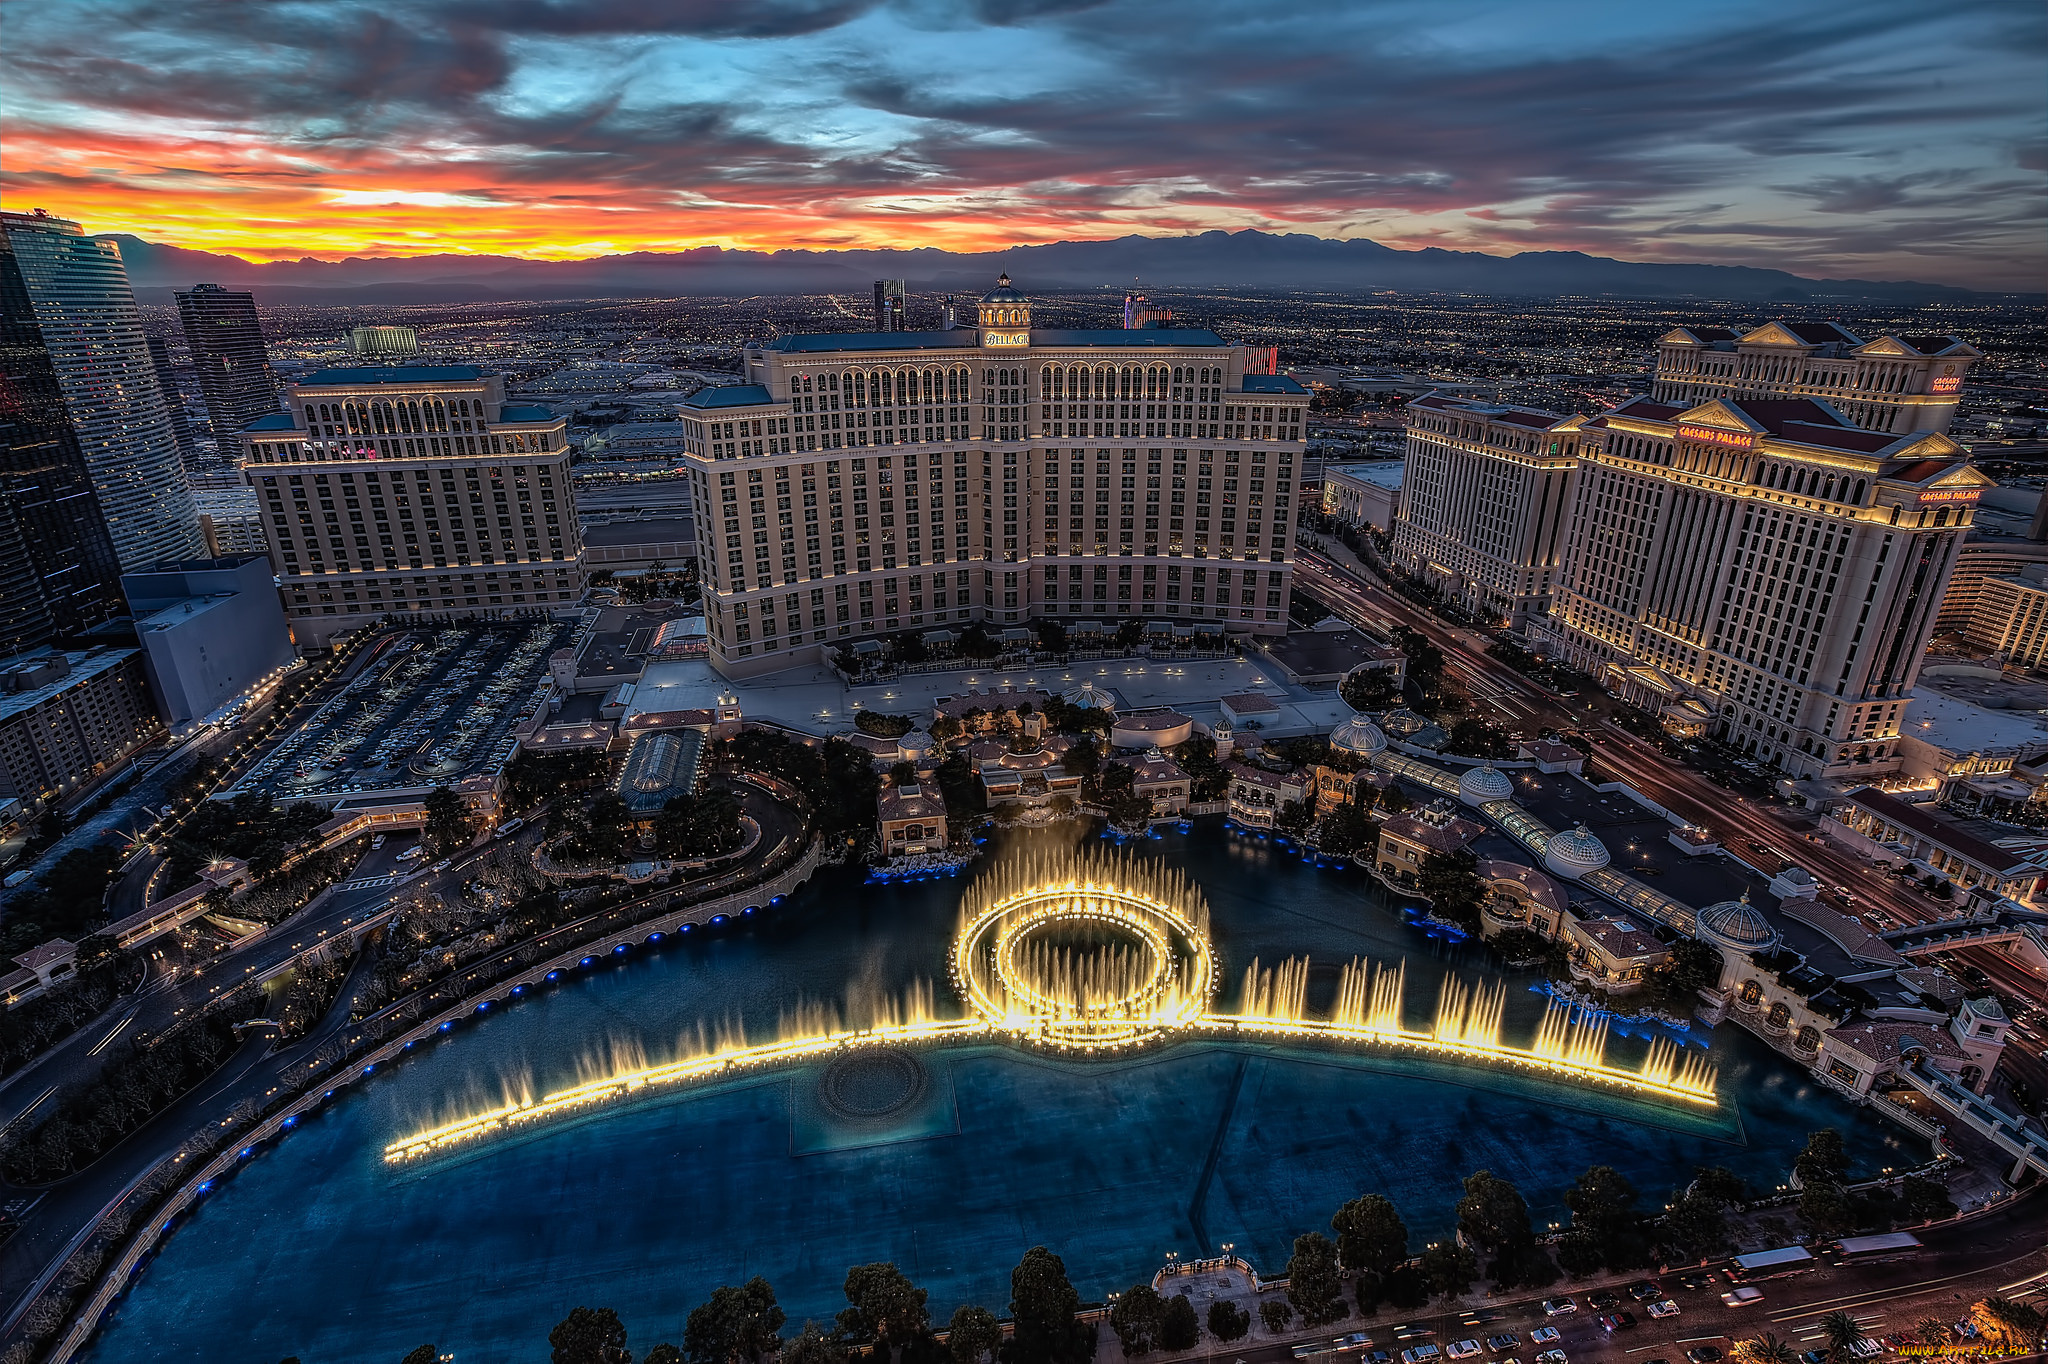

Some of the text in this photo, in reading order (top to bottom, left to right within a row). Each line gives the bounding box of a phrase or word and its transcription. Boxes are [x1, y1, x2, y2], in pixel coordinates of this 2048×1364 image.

[1933, 377, 1960, 385] CAESARS
[1679, 426, 1752, 447] CAESARS PALACE
[1920, 491, 1980, 501] CAESARS PALACE
